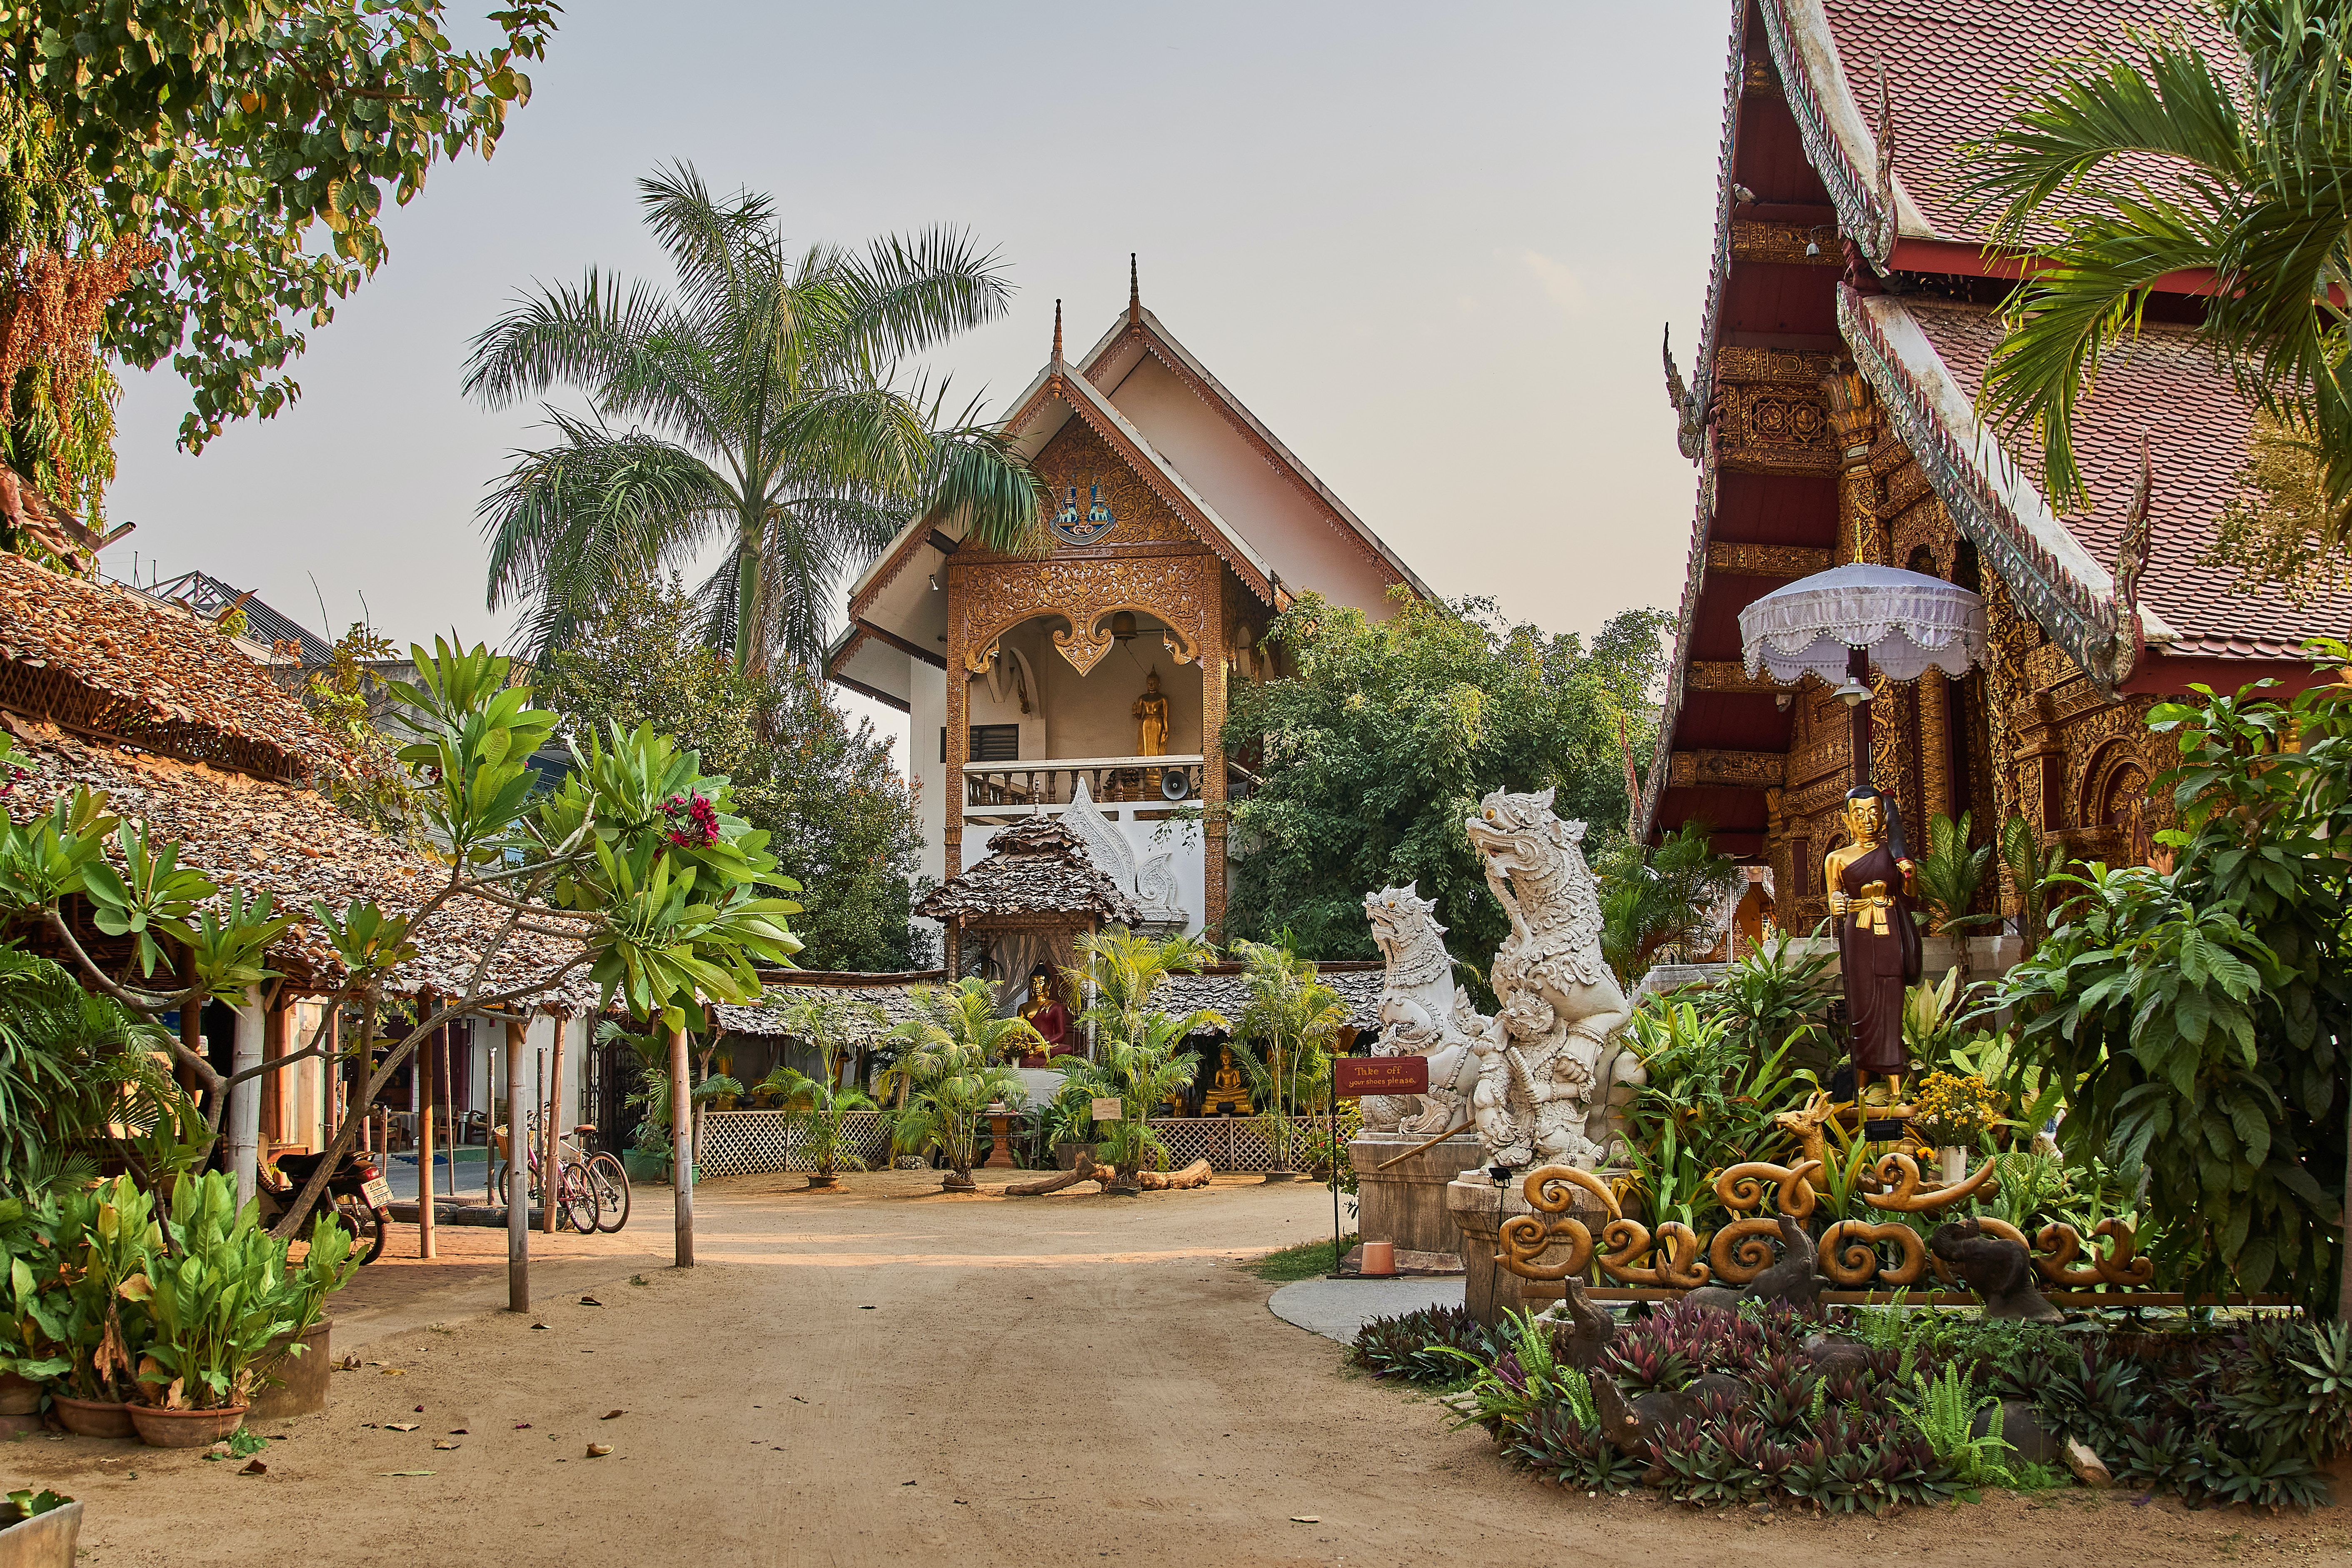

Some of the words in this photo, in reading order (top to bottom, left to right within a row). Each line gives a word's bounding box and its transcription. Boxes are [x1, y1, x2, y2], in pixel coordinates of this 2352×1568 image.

[1354, 1066, 1379, 1076] Take
[1387, 1066, 1402, 1074] off
[1387, 1076, 1416, 1086] please.
[374, 1194, 388, 1204] 1577
